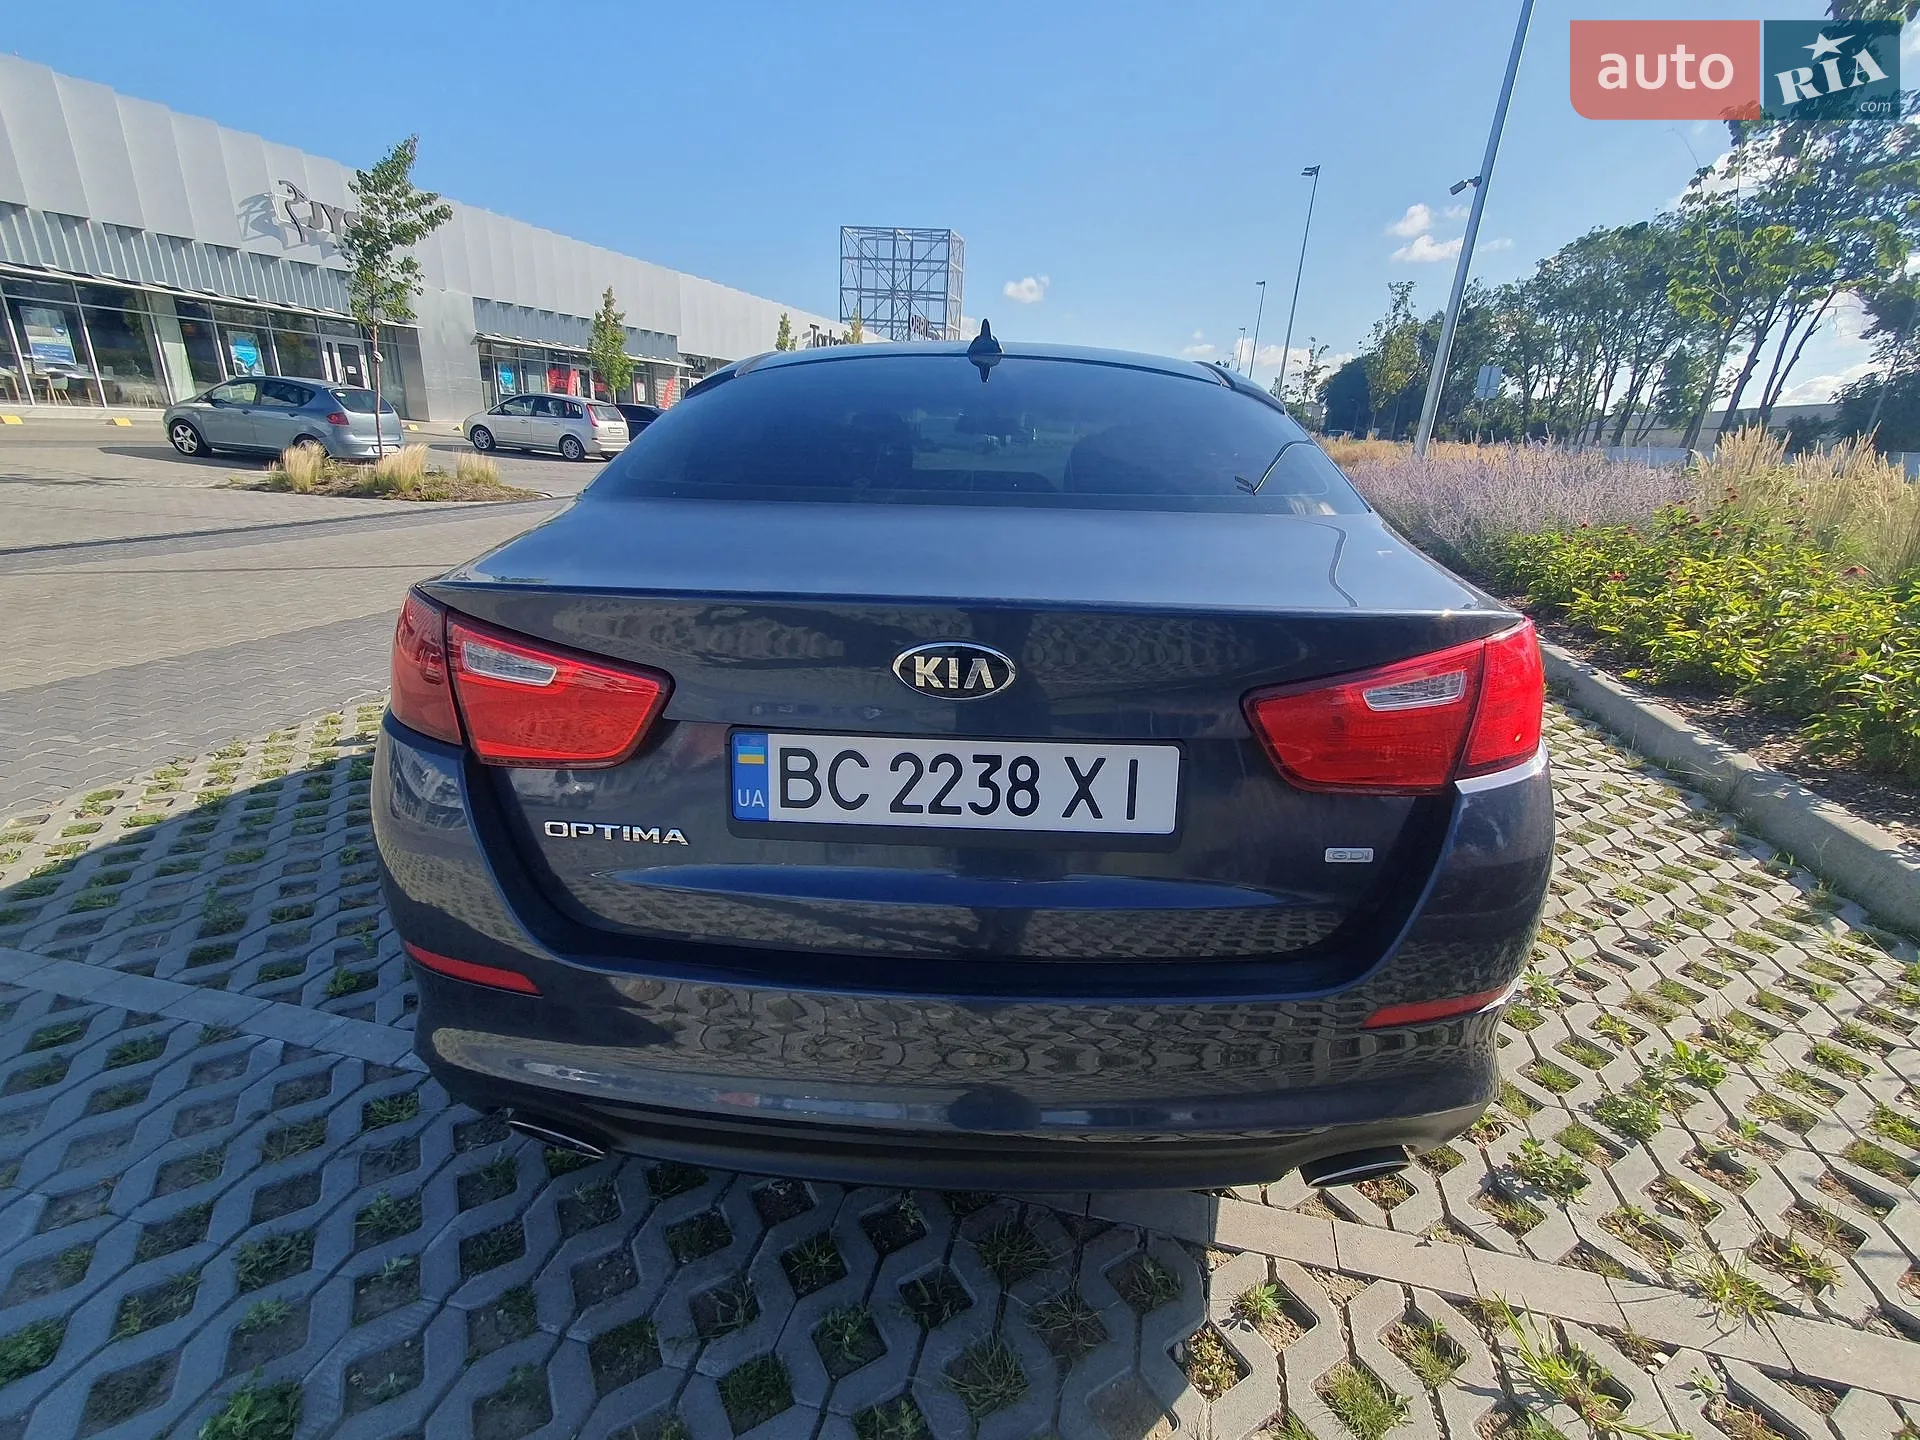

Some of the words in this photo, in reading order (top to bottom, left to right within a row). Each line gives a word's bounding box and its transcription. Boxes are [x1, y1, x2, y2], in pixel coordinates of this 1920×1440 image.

[914, 656, 994, 689] KIA
[779, 747, 870, 811] BC
[889, 752, 1040, 817] 2238
[737, 788, 765, 807] UA
[544, 821, 689, 846] OPTIMA
